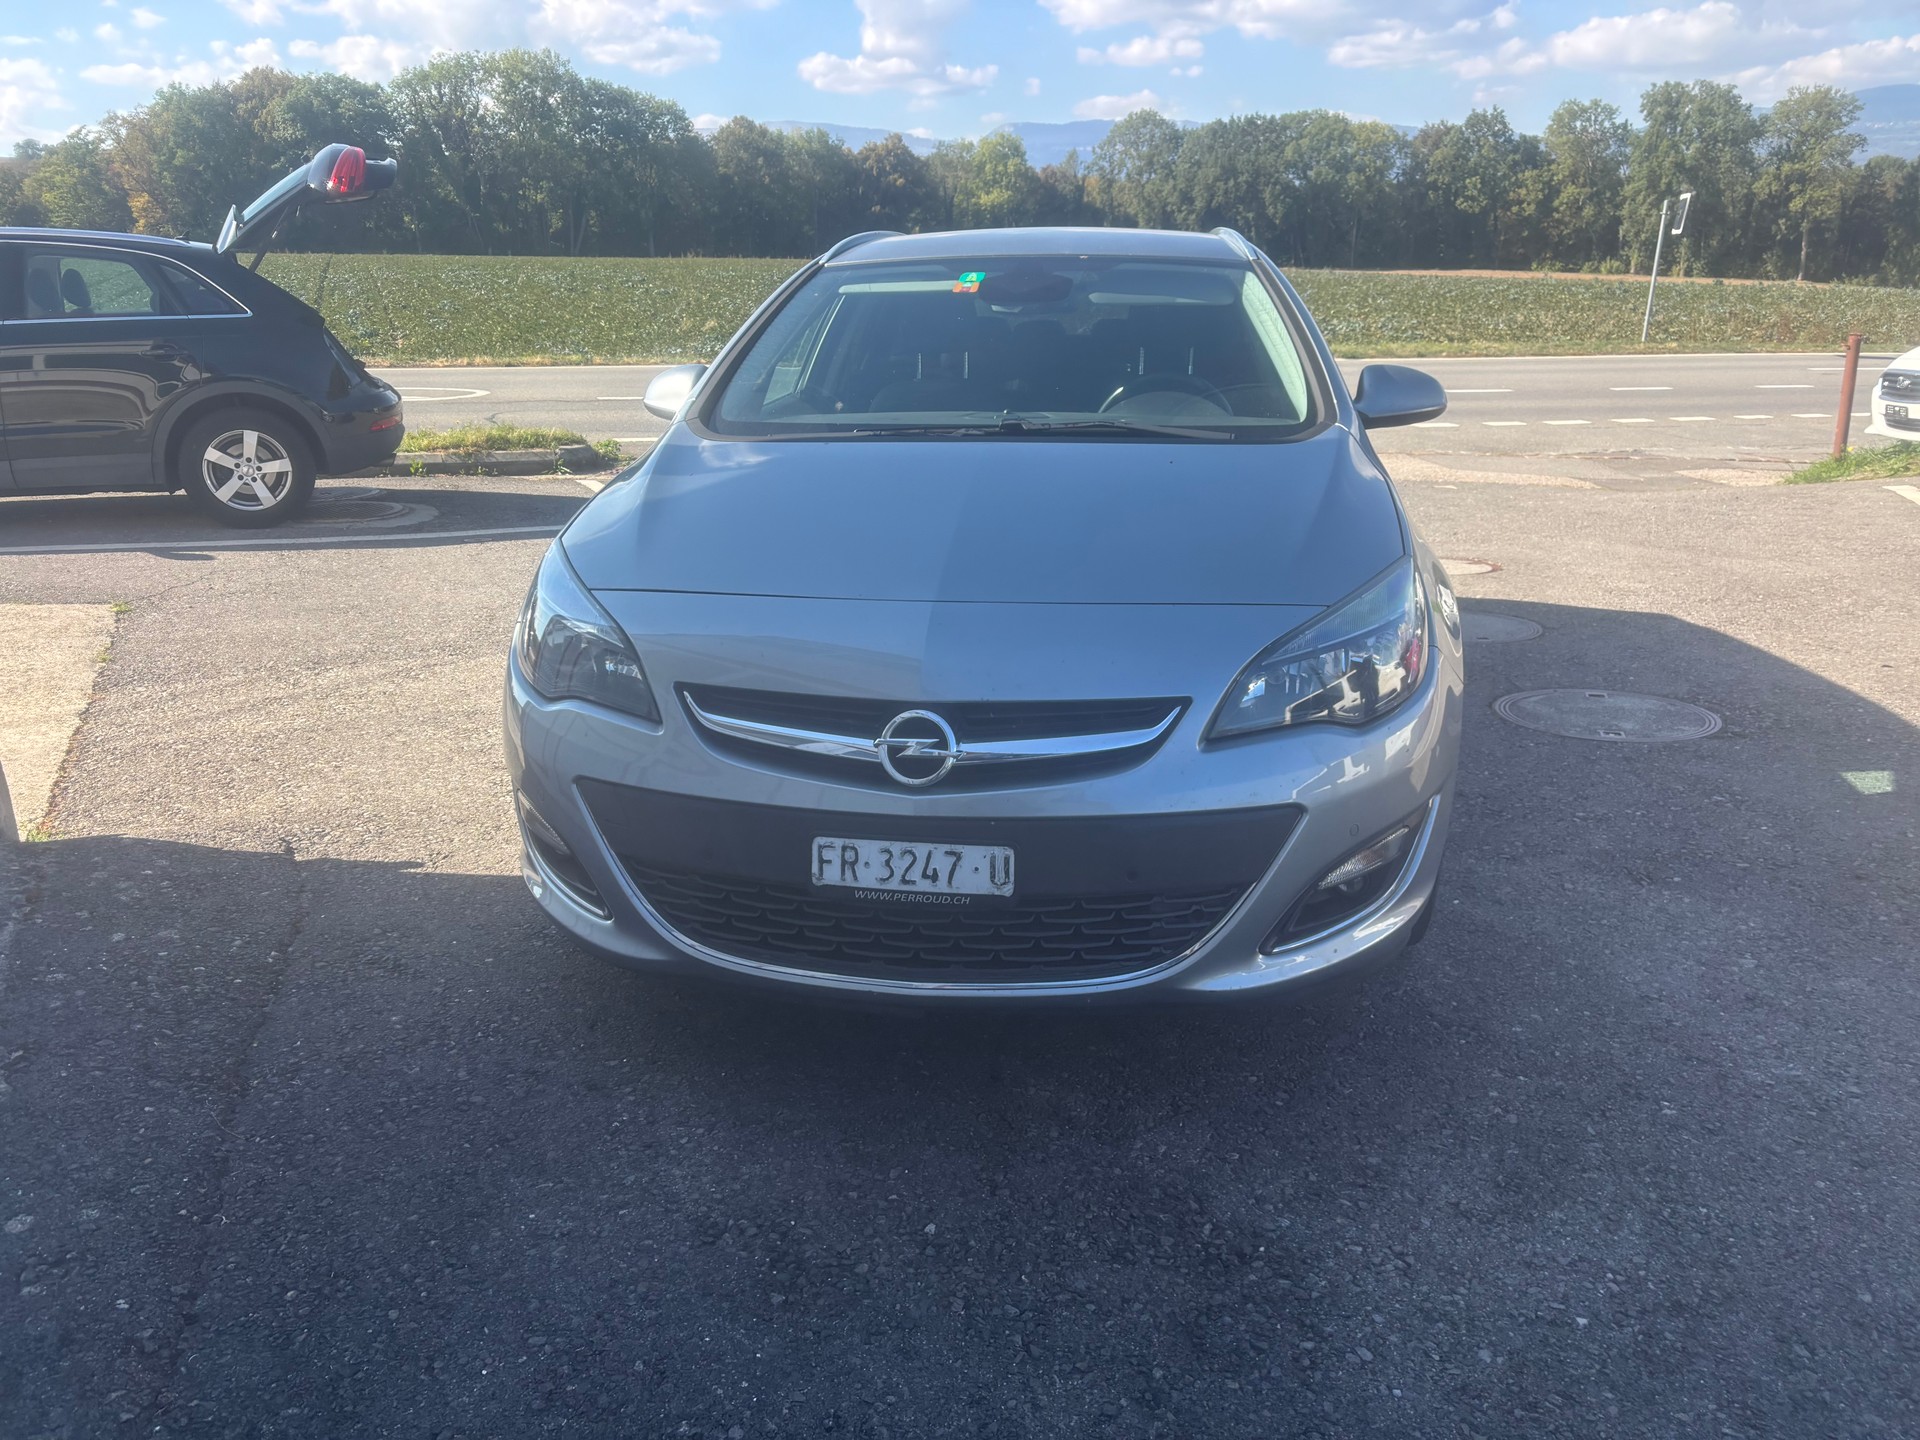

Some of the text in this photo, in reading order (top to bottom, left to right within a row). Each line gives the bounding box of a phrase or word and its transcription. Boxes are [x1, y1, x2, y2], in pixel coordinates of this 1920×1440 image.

[817, 842, 860, 882] FR
[876, 847, 963, 887] 3247
[853, 890, 970, 905] WWW.PERROUD.CH
